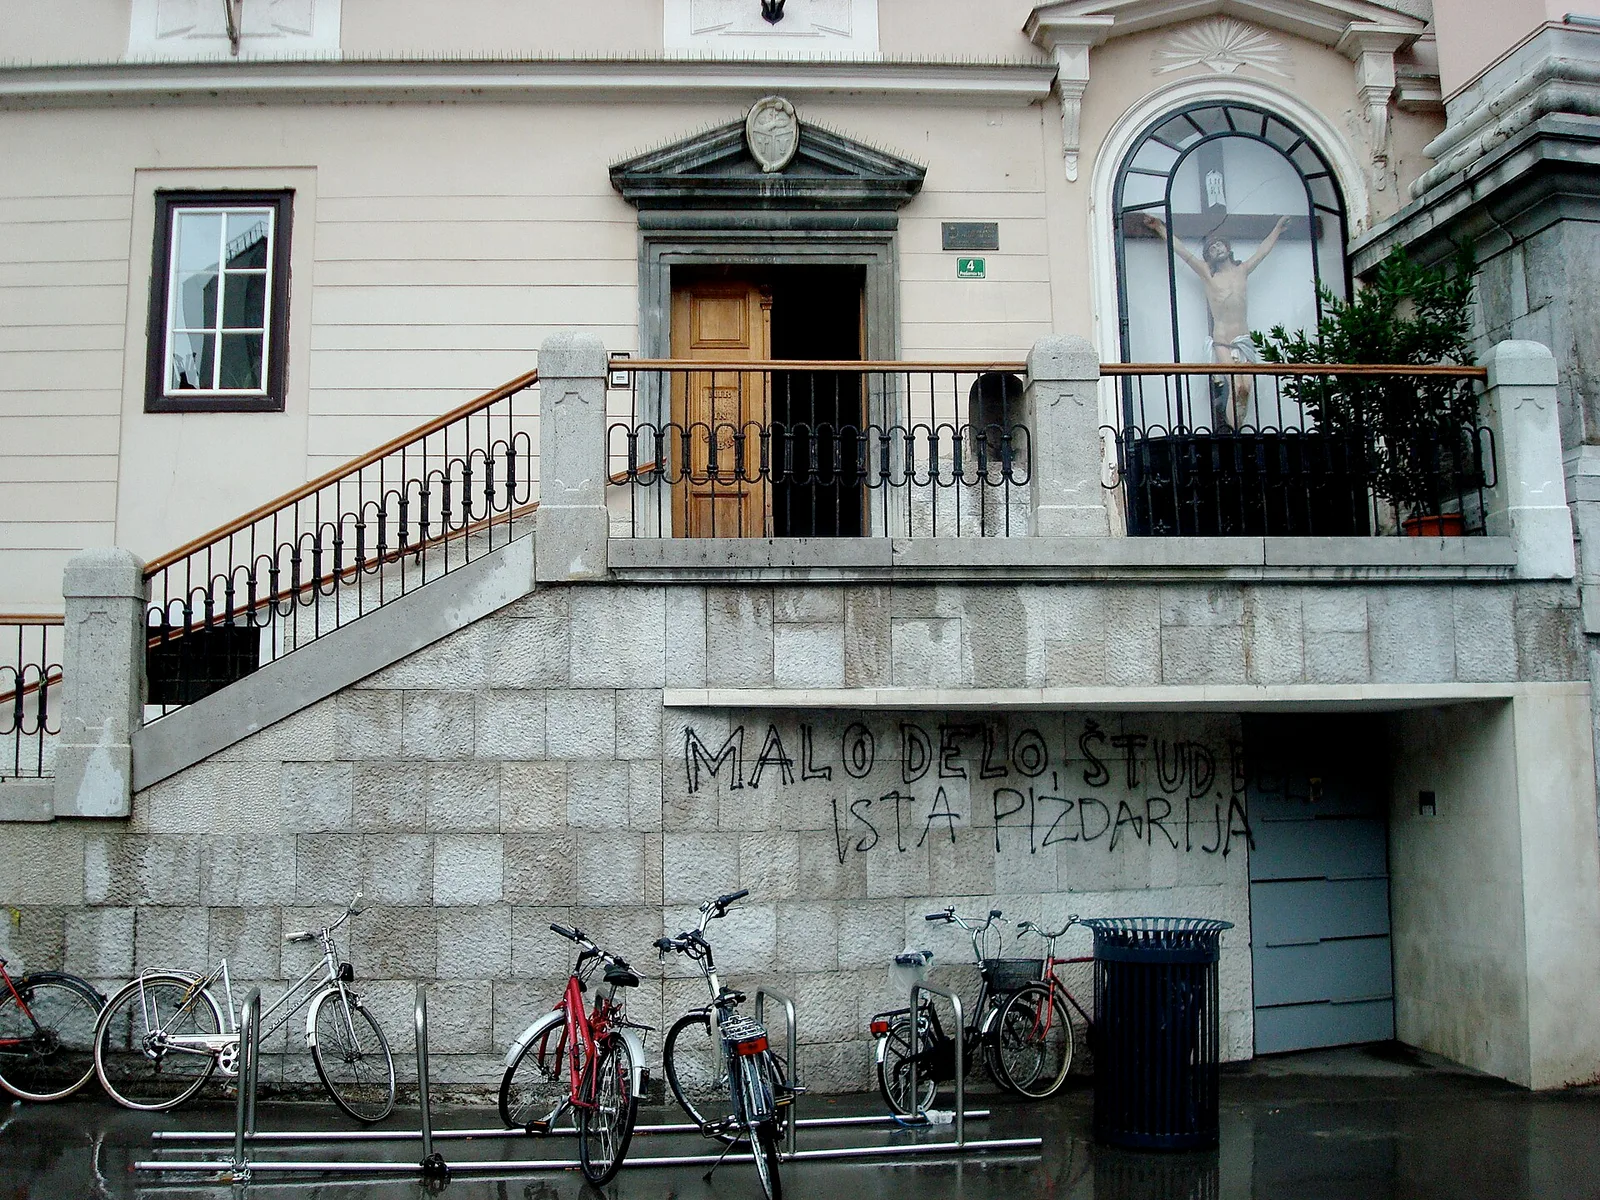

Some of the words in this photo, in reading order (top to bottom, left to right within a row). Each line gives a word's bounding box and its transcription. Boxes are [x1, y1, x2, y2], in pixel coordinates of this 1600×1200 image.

[966, 260, 975, 271] 4
[684, 722, 875, 793] MALO
[831, 784, 961, 864] ISTA
[993, 787, 1256, 862] PIZDARIJA
